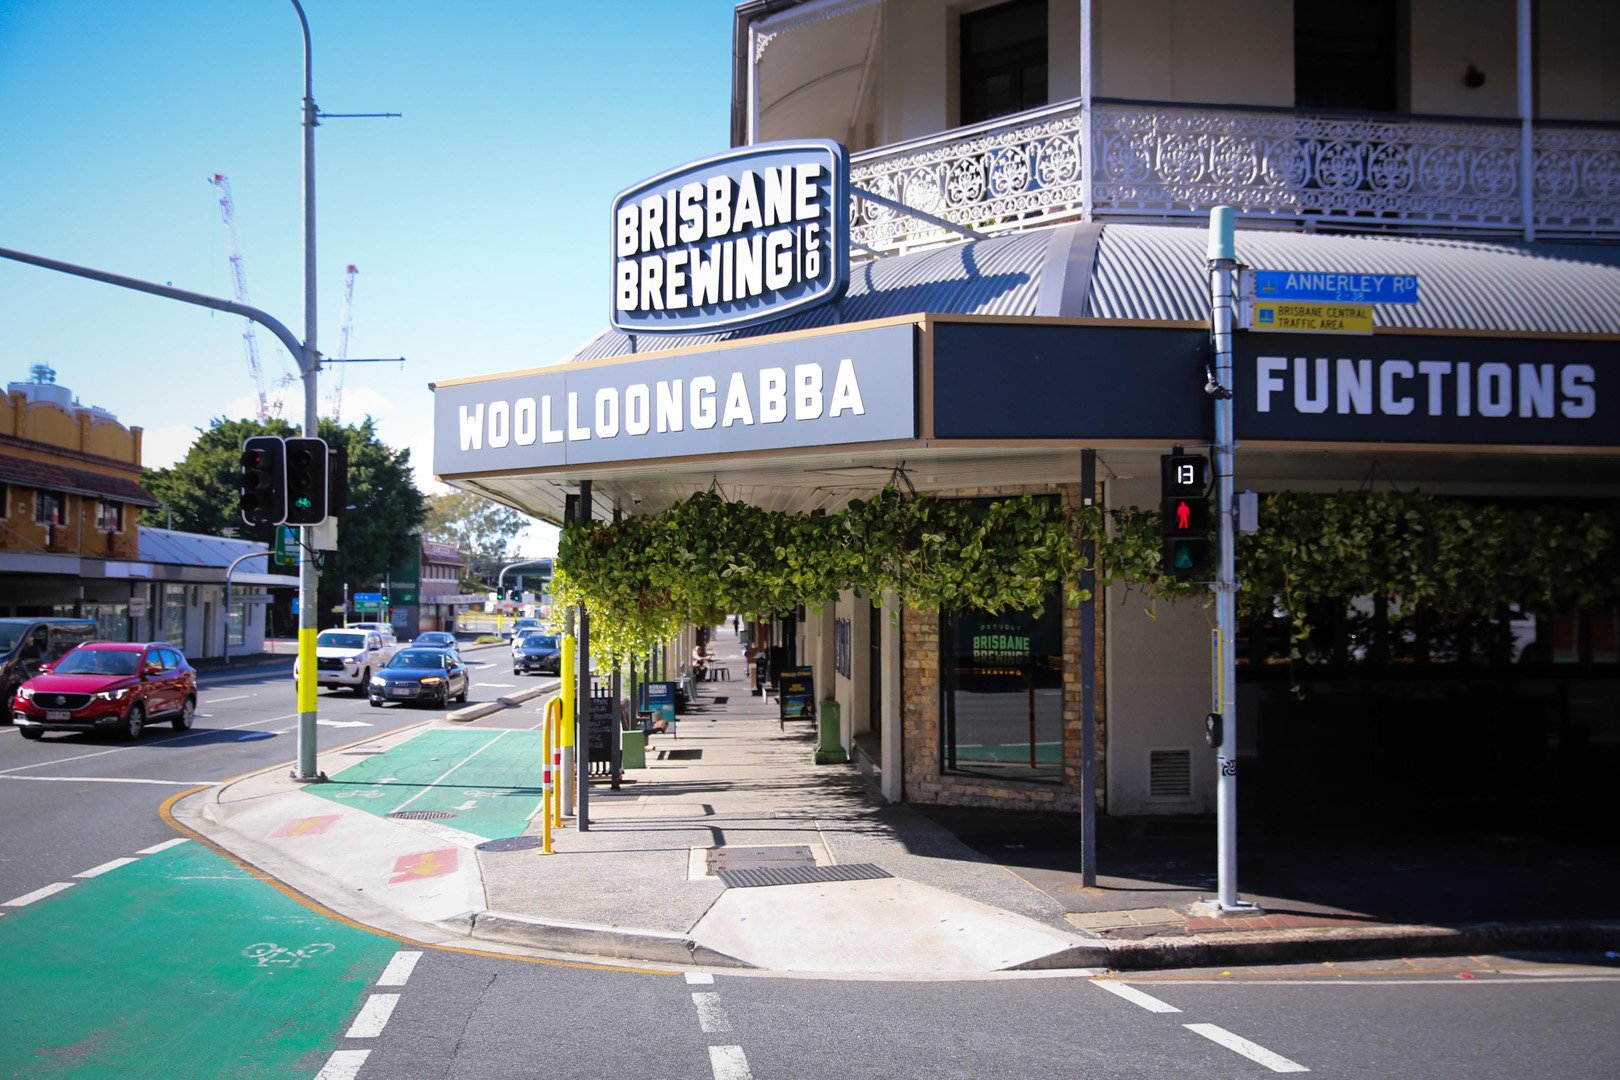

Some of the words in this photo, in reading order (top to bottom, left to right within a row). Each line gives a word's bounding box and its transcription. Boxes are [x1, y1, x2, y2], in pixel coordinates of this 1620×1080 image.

[617, 163, 821, 258] BRISBANE
[617, 228, 793, 311] BREWING
[1285, 273, 1386, 293] ANNERLEY
[1278, 306, 1322, 318] BRISBANE
[1326, 307, 1368, 319] CENTRAL
[1278, 317, 1316, 329] TRAFFIC
[1320, 319, 1344, 330] AREA
[1256, 356, 1596, 419] FUNCTIONS
[459, 358, 866, 452] WOOLLOONGABBA
[1177, 464, 1194, 485] 13
[973, 634, 1030, 651] BRISBANE
